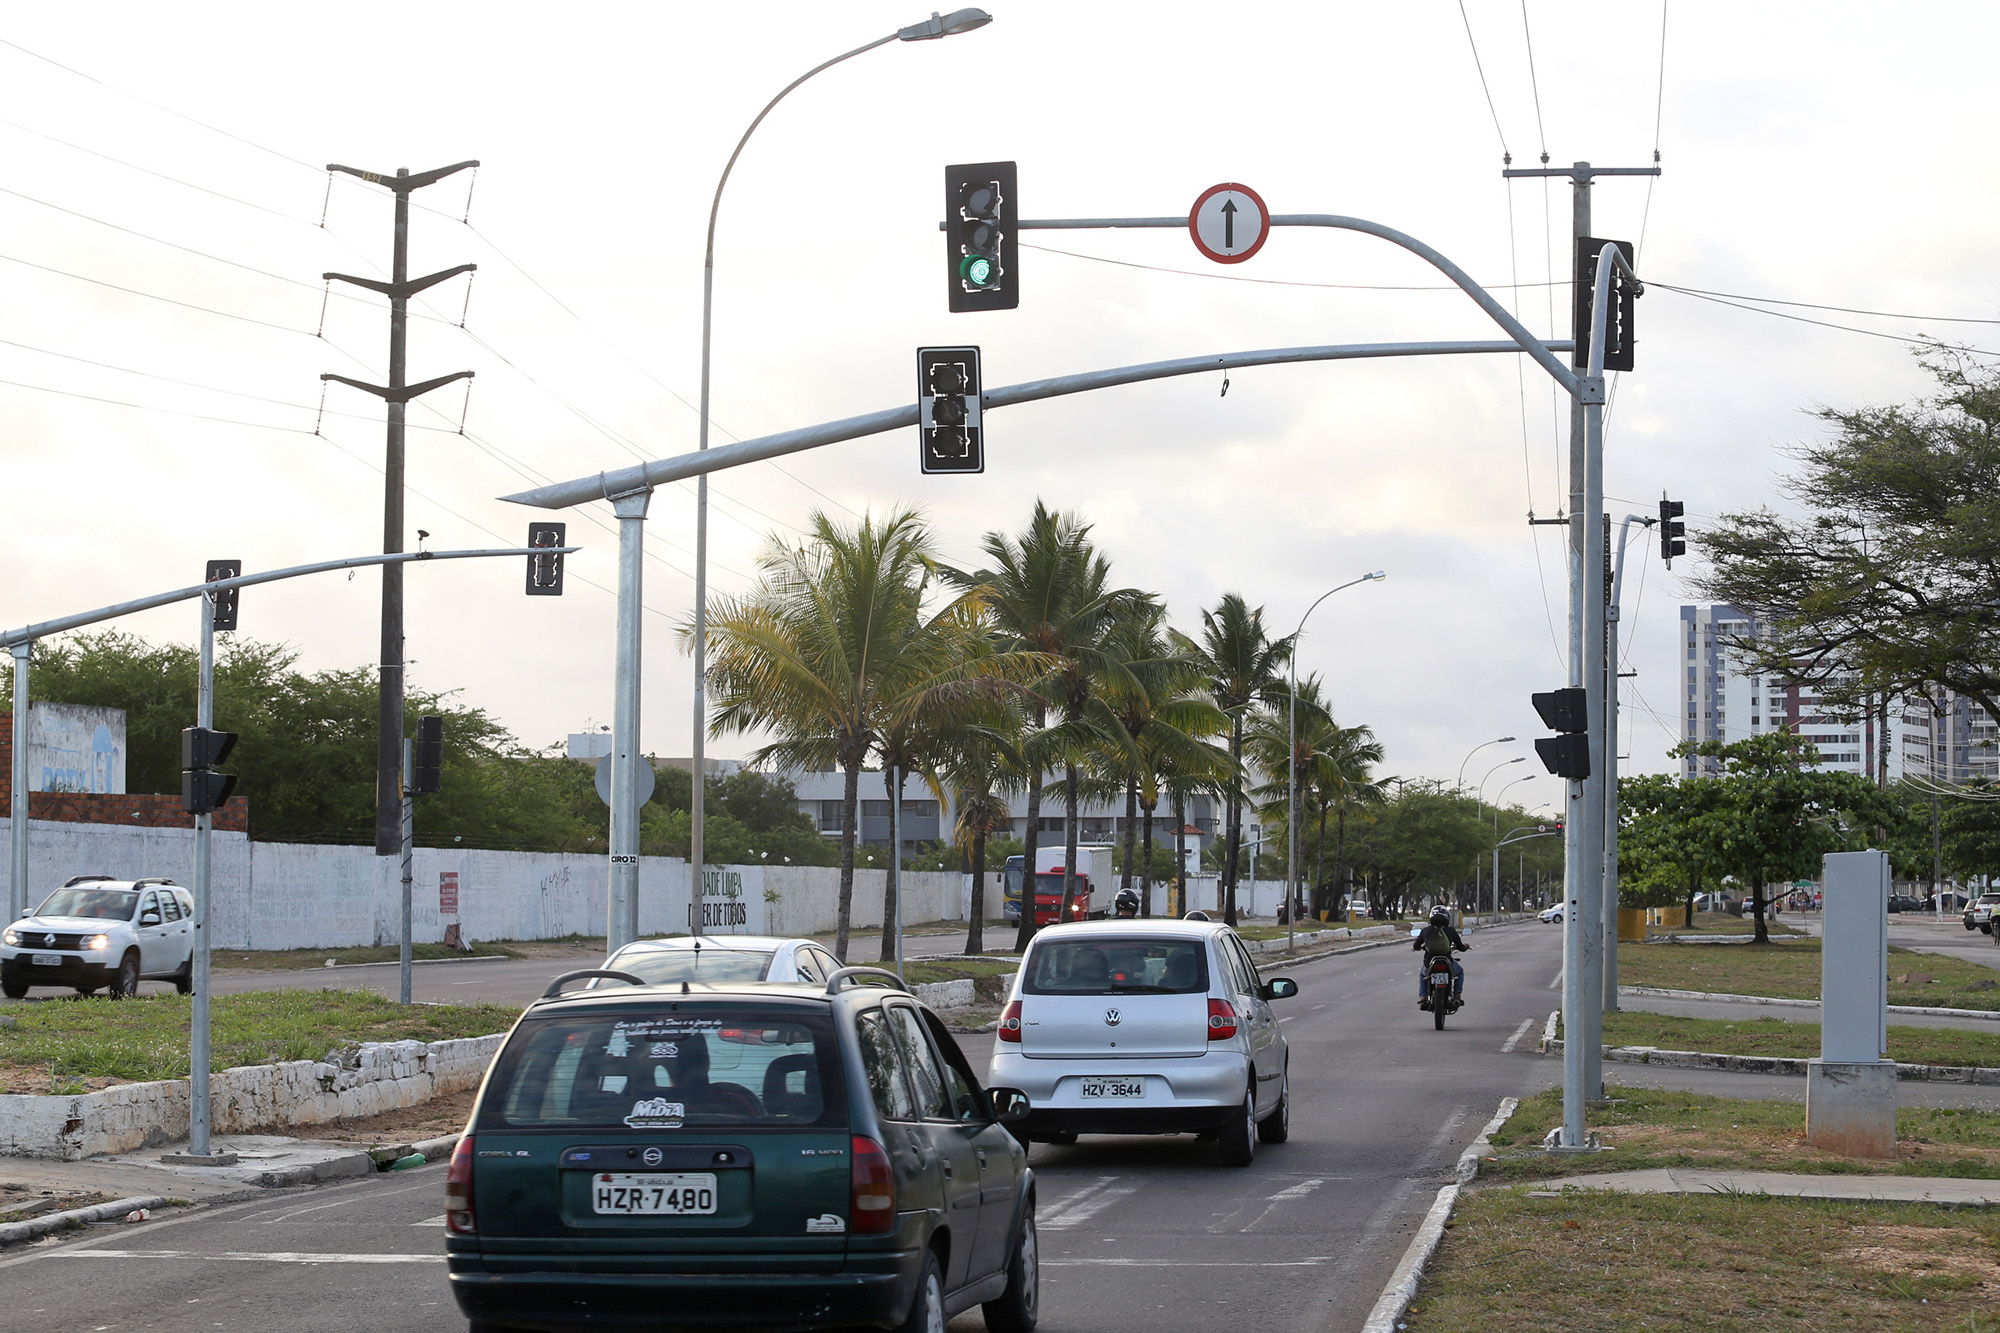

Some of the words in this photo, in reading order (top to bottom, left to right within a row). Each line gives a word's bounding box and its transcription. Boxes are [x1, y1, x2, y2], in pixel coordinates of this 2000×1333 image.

[722, 871, 743, 896] LIMPA
[713, 903, 723, 926] DE
[724, 902, 747, 926] TODOS
